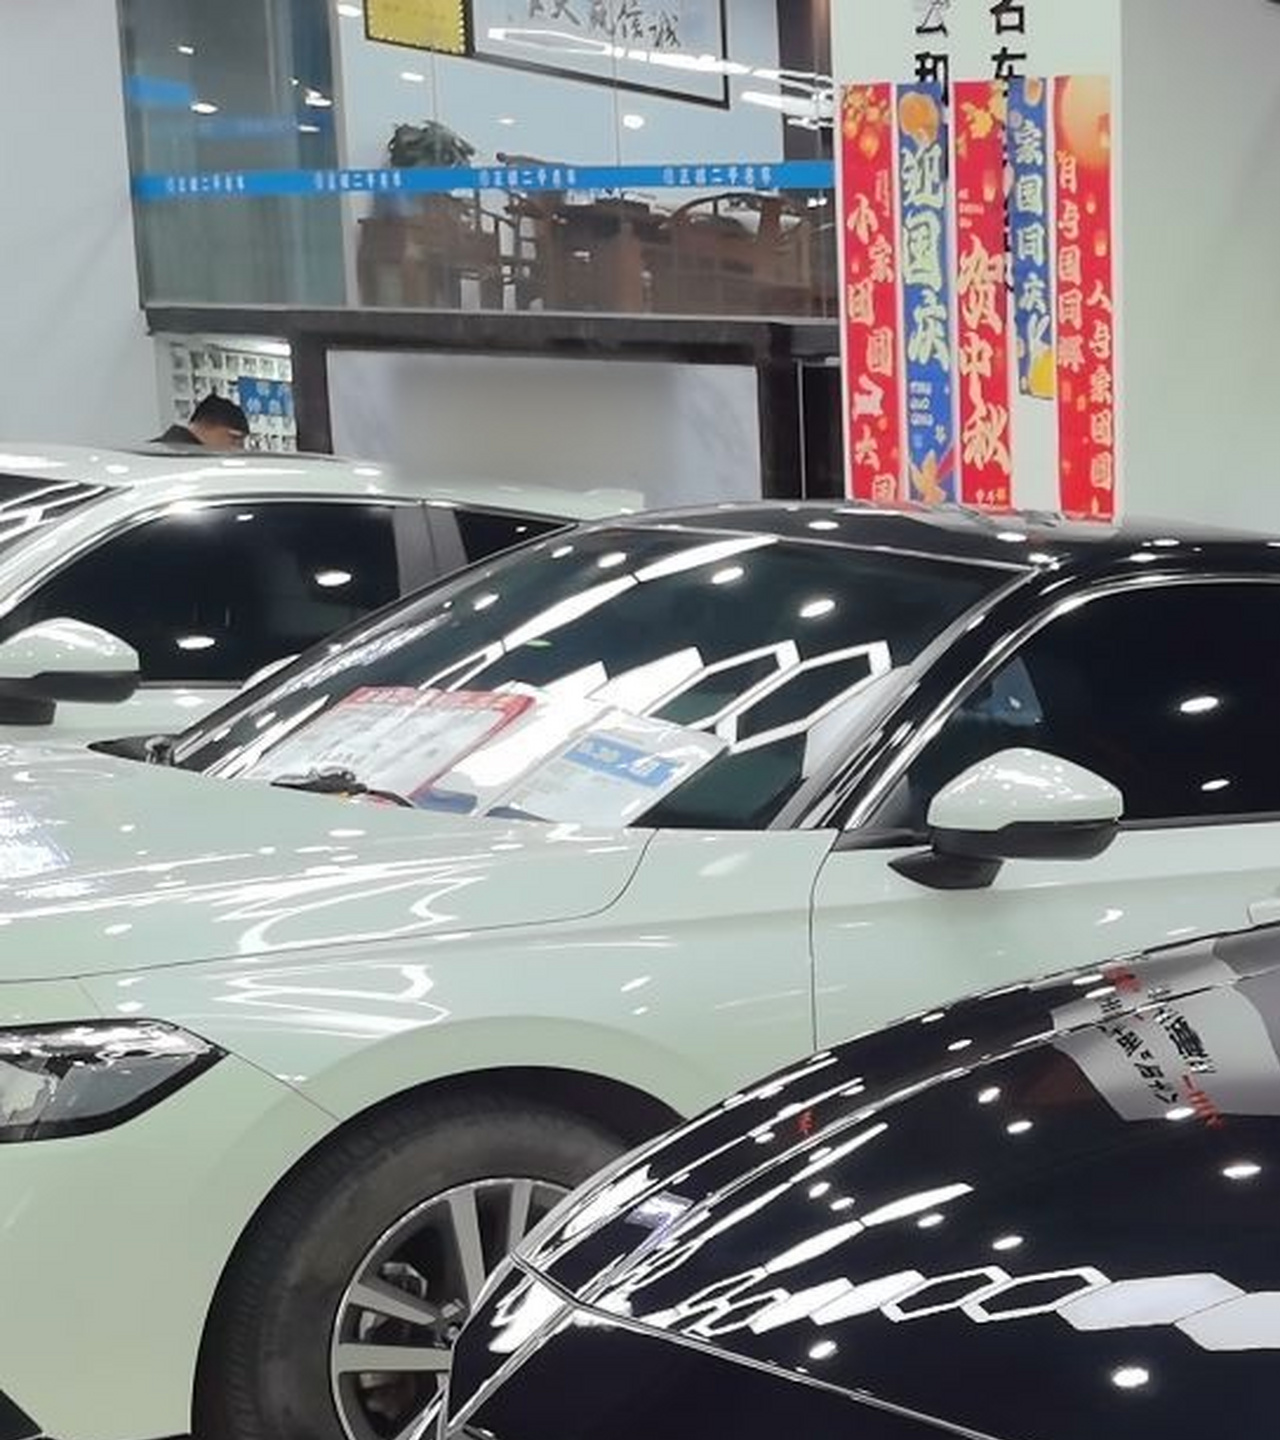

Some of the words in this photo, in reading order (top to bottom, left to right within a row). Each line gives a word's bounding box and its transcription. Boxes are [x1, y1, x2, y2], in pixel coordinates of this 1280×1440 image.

[900, 143, 949, 372] 迎国庆
[959, 233, 1011, 475] 贺中秋
